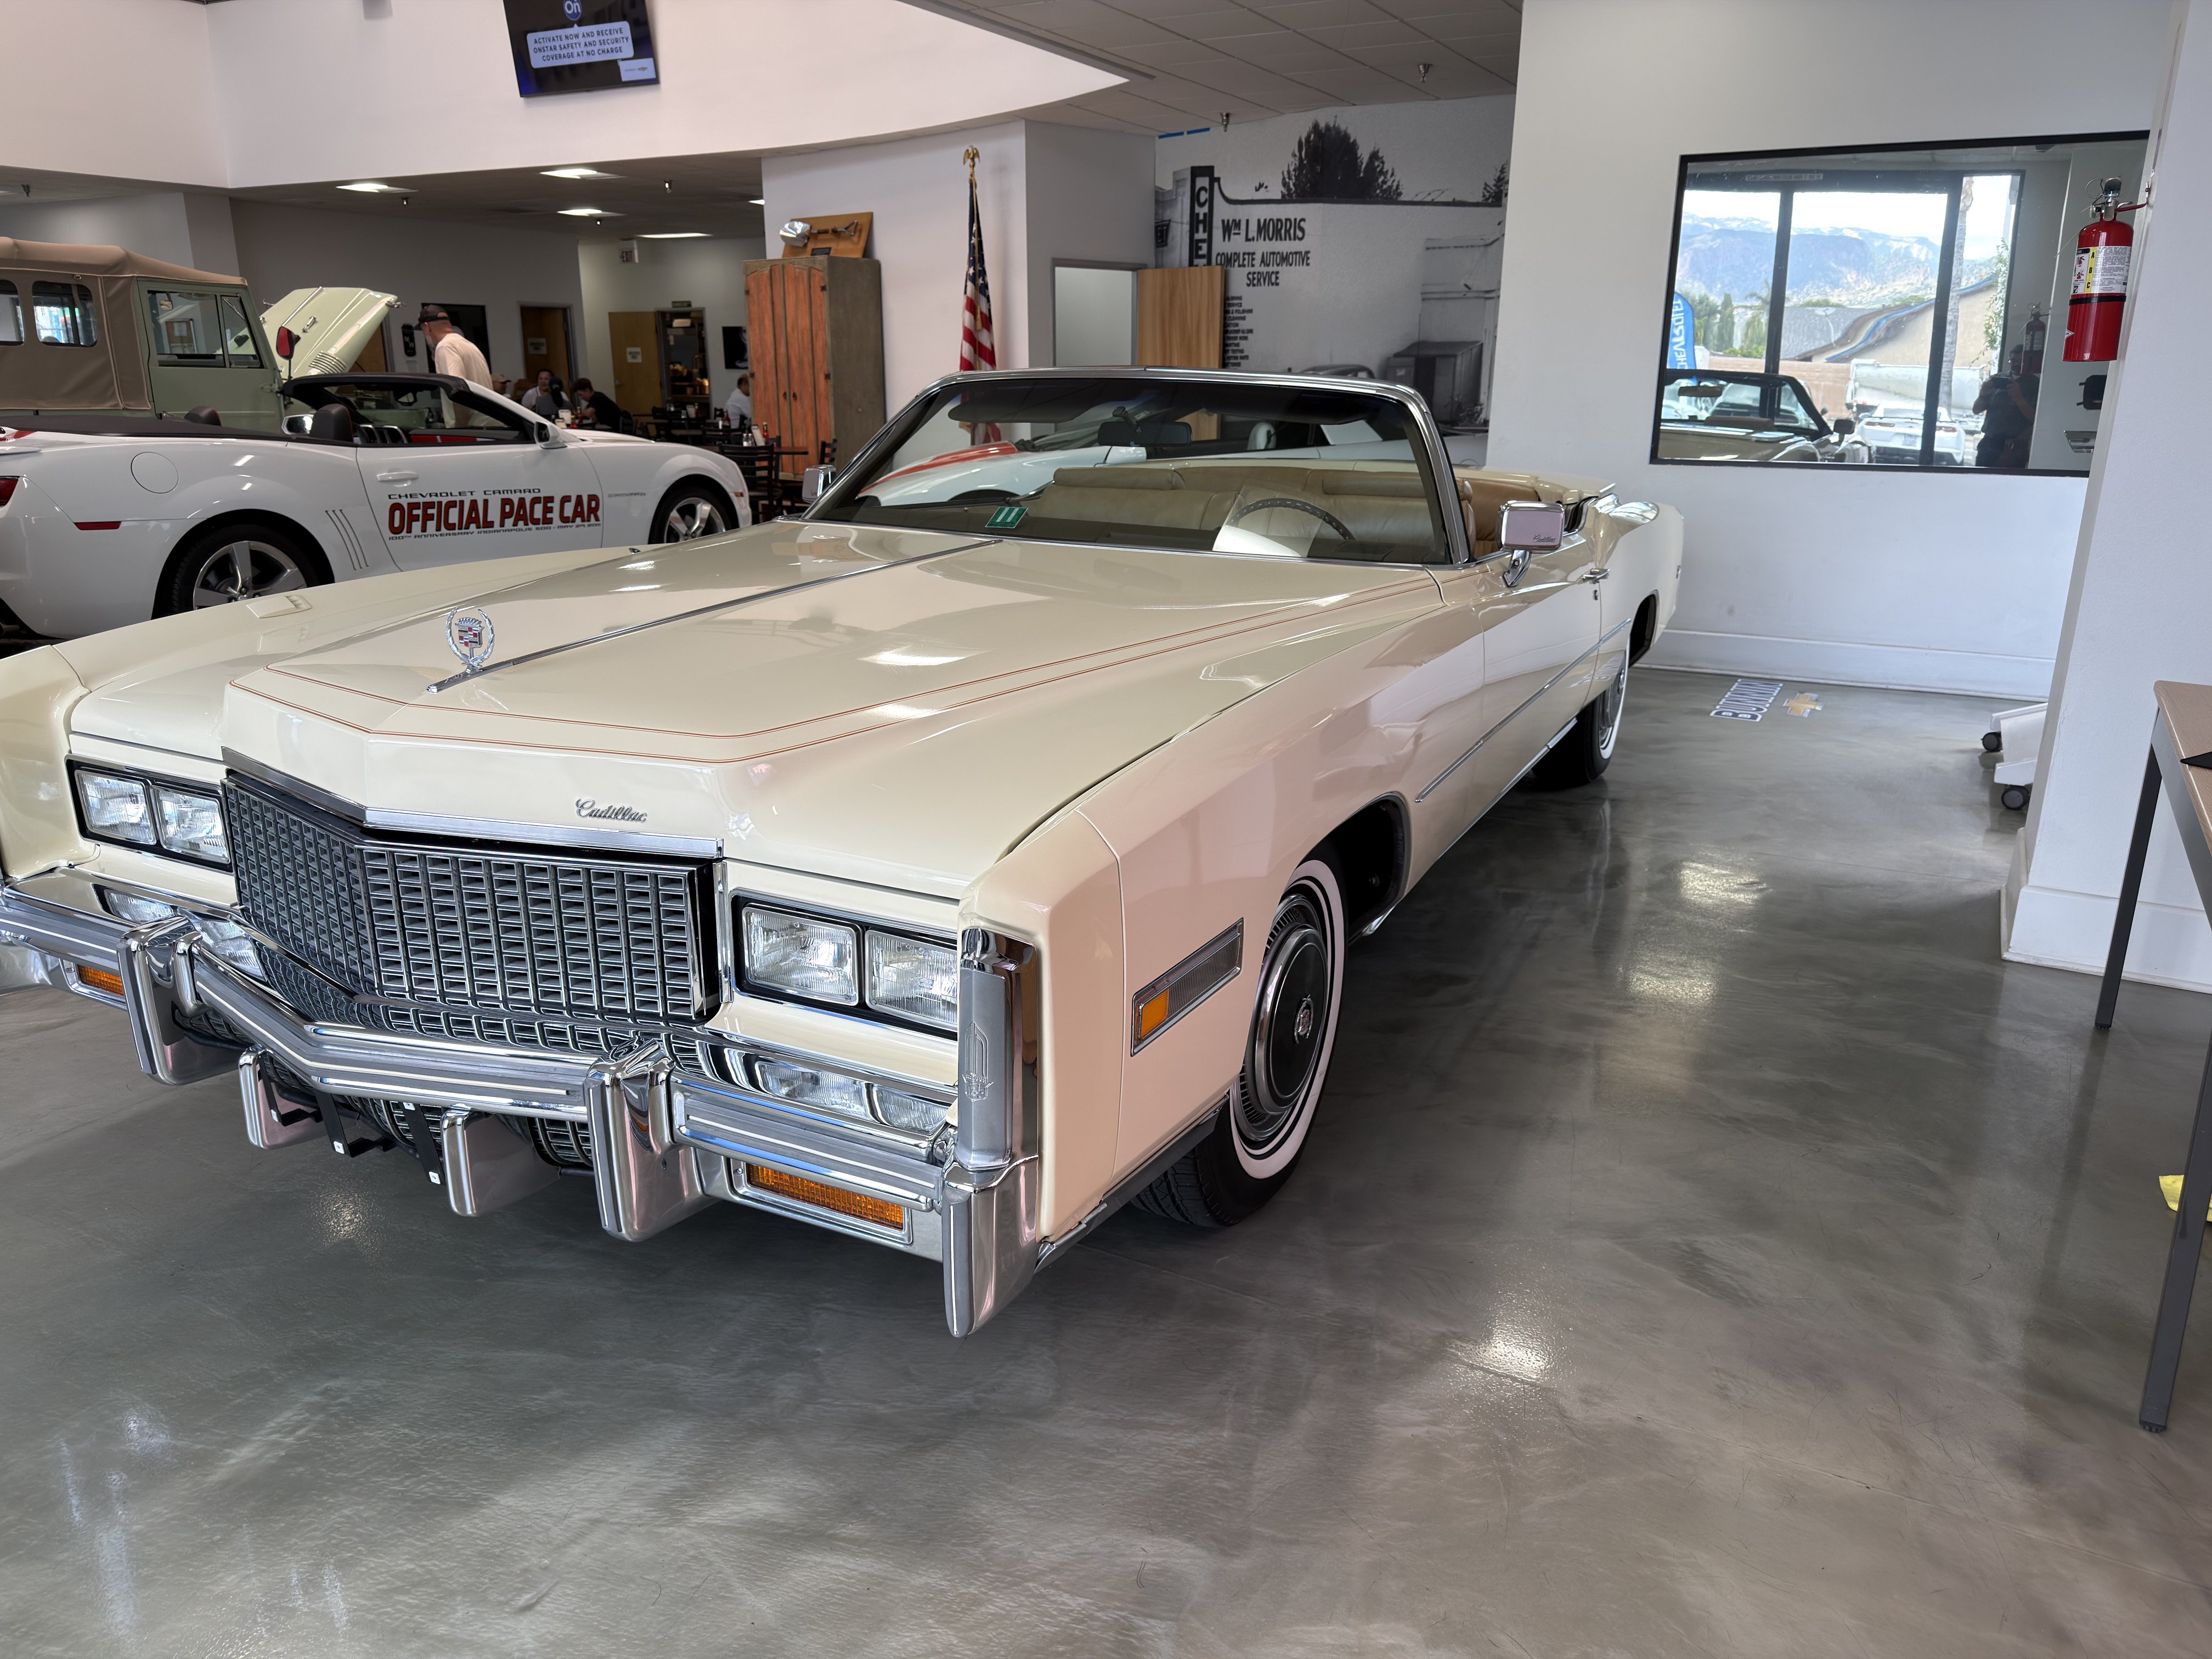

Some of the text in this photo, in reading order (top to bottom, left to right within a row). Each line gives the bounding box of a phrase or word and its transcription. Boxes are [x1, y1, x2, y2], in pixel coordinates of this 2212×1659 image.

[534, 35, 563, 44] ACTIVATE
[597, 27, 623, 36] RECEIVE
[533, 46, 557, 54] ONSTAR
[559, 42, 582, 50] SAFETY
[599, 36, 629, 46] SECURITY
[542, 53, 574, 61] COVERAGE
[597, 47, 623, 55] CHARGE
[1195, 186, 1208, 267] CHE
[1256, 218, 1306, 241] MORRIS
[1216, 251, 1311, 268] COMPLETE AUTOMOTIVE
[1246, 271, 1279, 287] SERVICE
[388, 490, 475, 499] CHEVROLET
[388, 494, 600, 535] OFFICIAL PACE CAR
[414, 531, 475, 539] ANNIVERSARY
[1532, 534, 1556, 543] Cadillac
[575, 798, 647, 822] Cadillac
